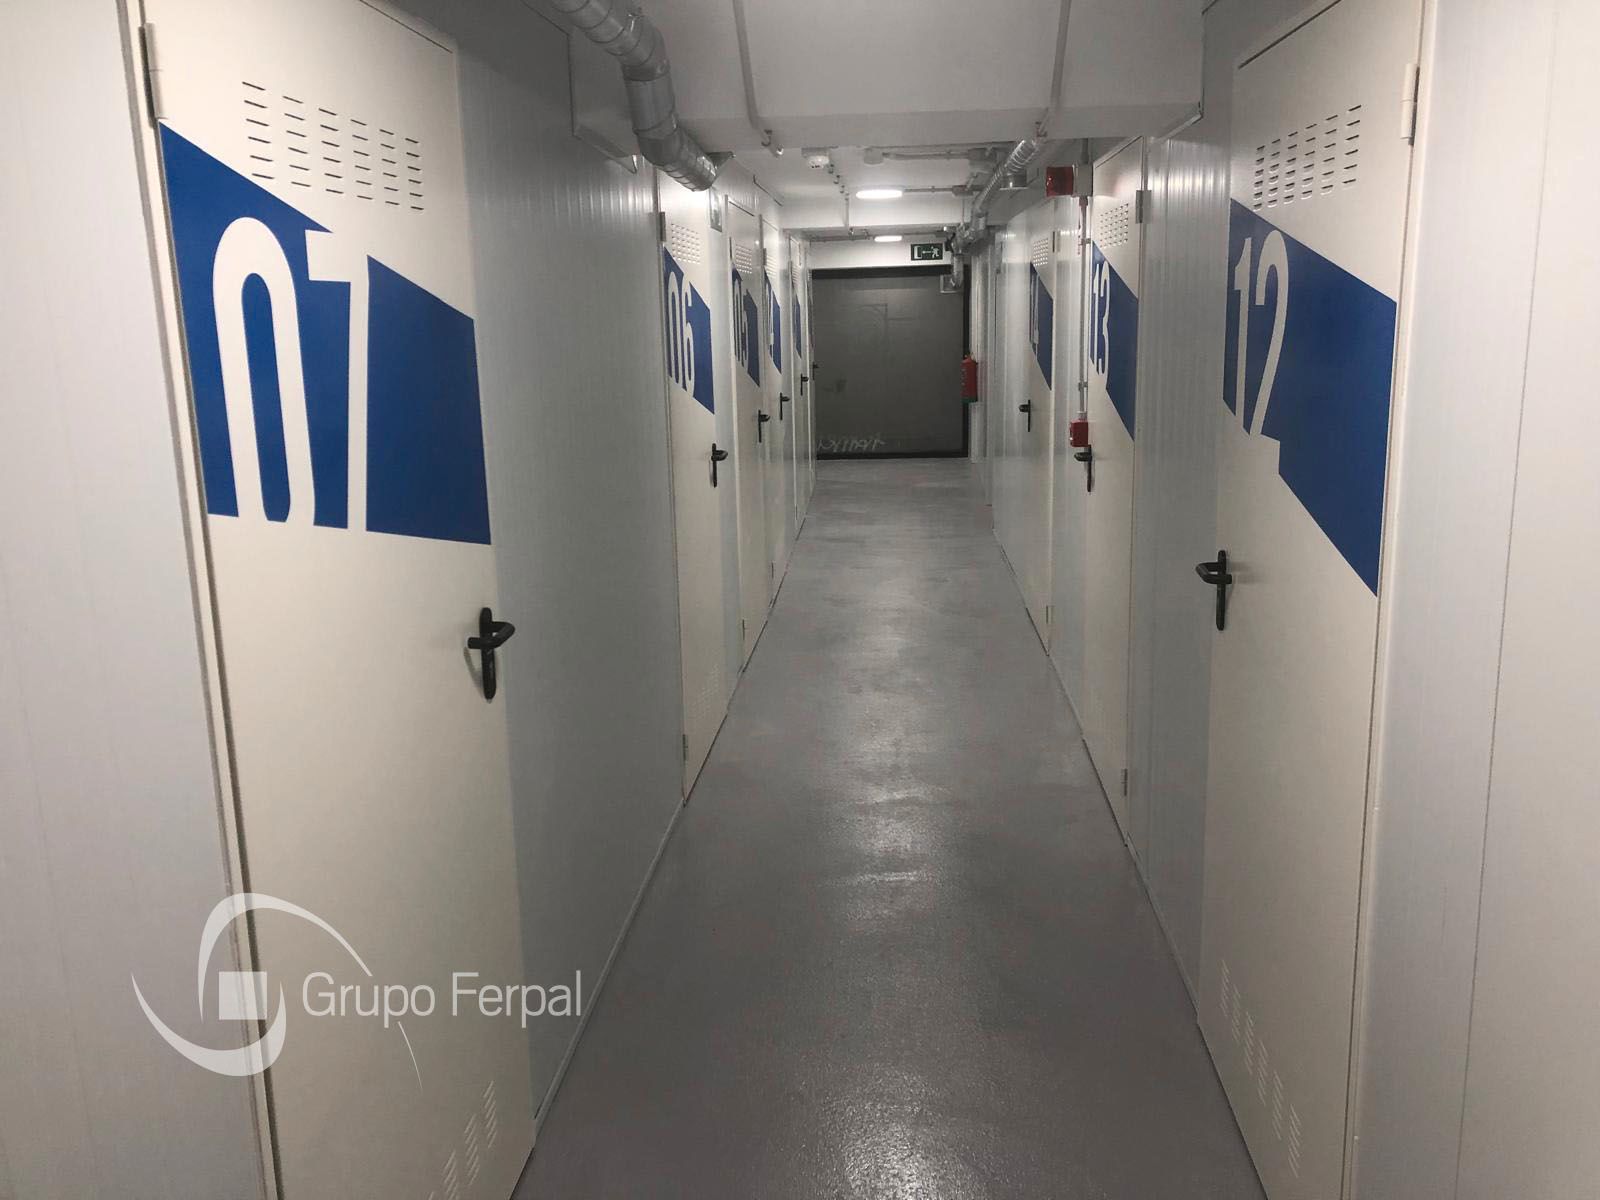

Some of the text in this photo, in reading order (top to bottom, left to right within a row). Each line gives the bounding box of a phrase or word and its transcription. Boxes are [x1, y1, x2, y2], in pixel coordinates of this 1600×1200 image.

[212, 216, 369, 532] 07
[668, 270, 695, 397] 06
[1093, 260, 1110, 387] 13
[1235, 230, 1289, 455] 12
